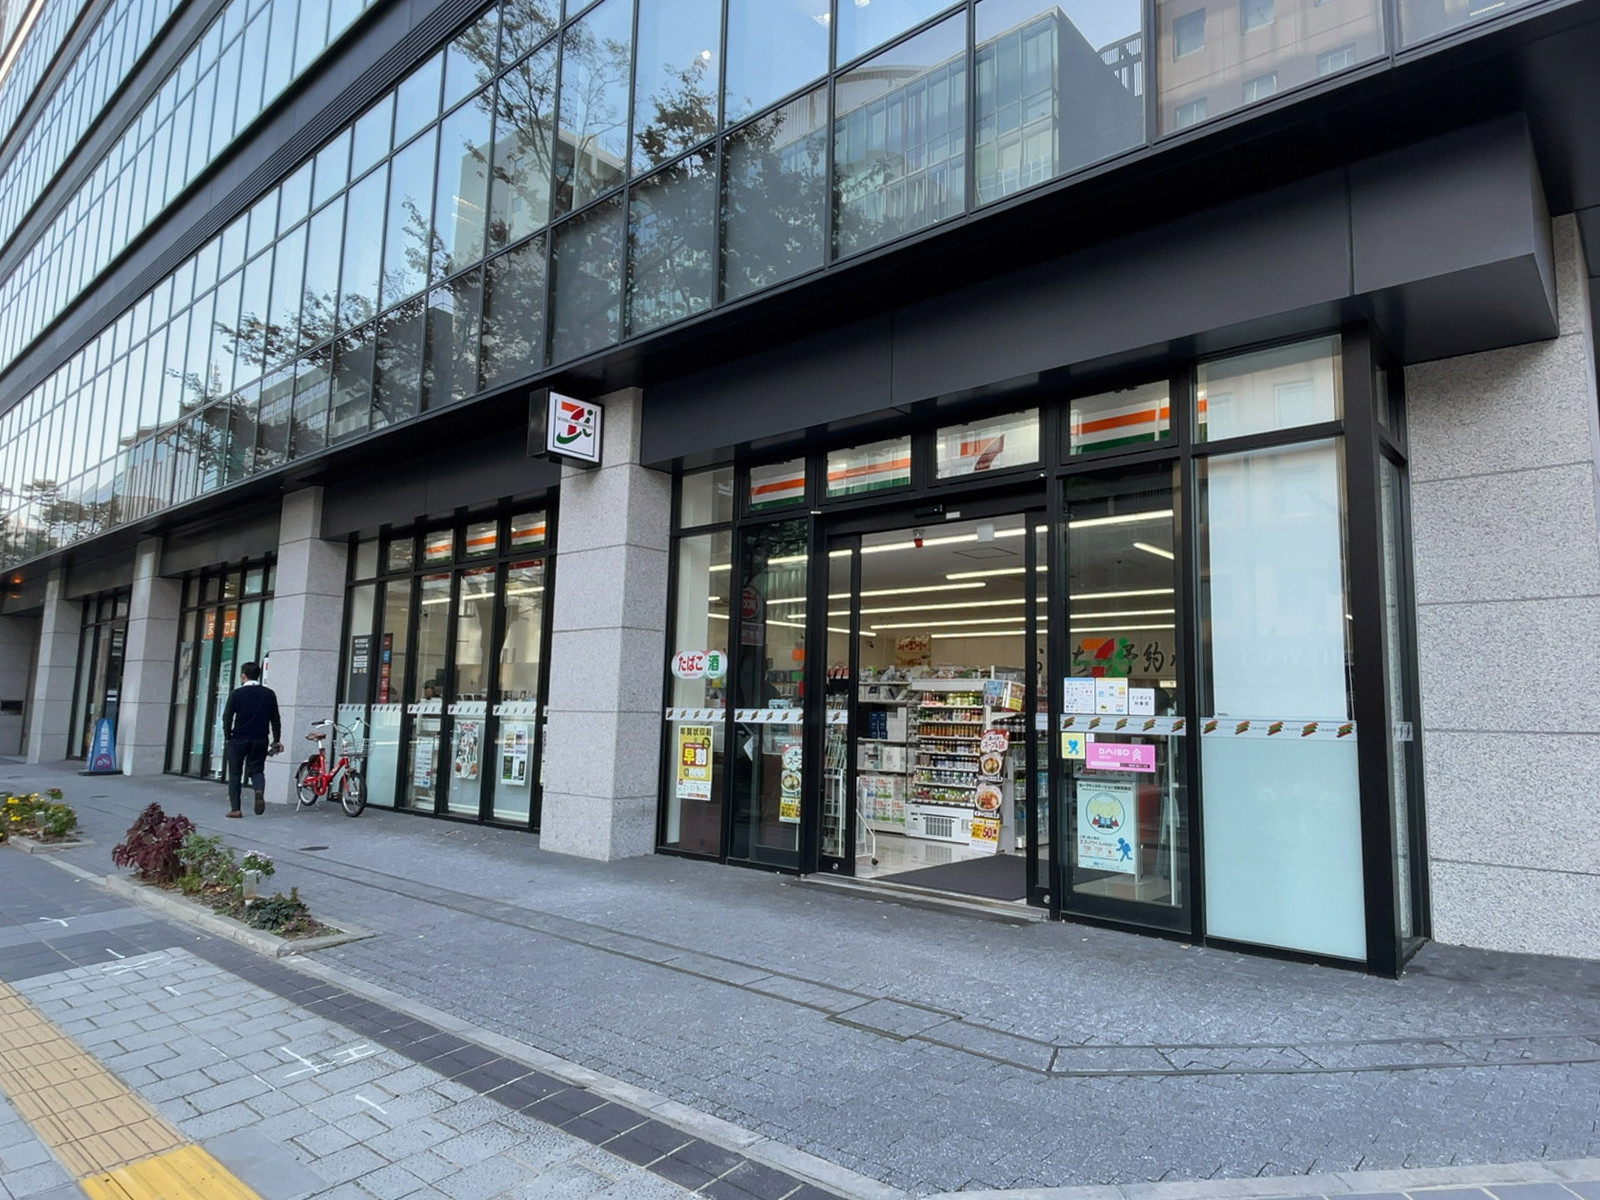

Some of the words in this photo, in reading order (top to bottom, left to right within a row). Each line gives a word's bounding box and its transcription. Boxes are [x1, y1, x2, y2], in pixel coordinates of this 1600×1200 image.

[678, 655, 703, 671] たばこ
[708, 655, 720, 671] 酒
[680, 727, 712, 737] 年賀状印刷
[1098, 748, 1130, 757] DAISO
